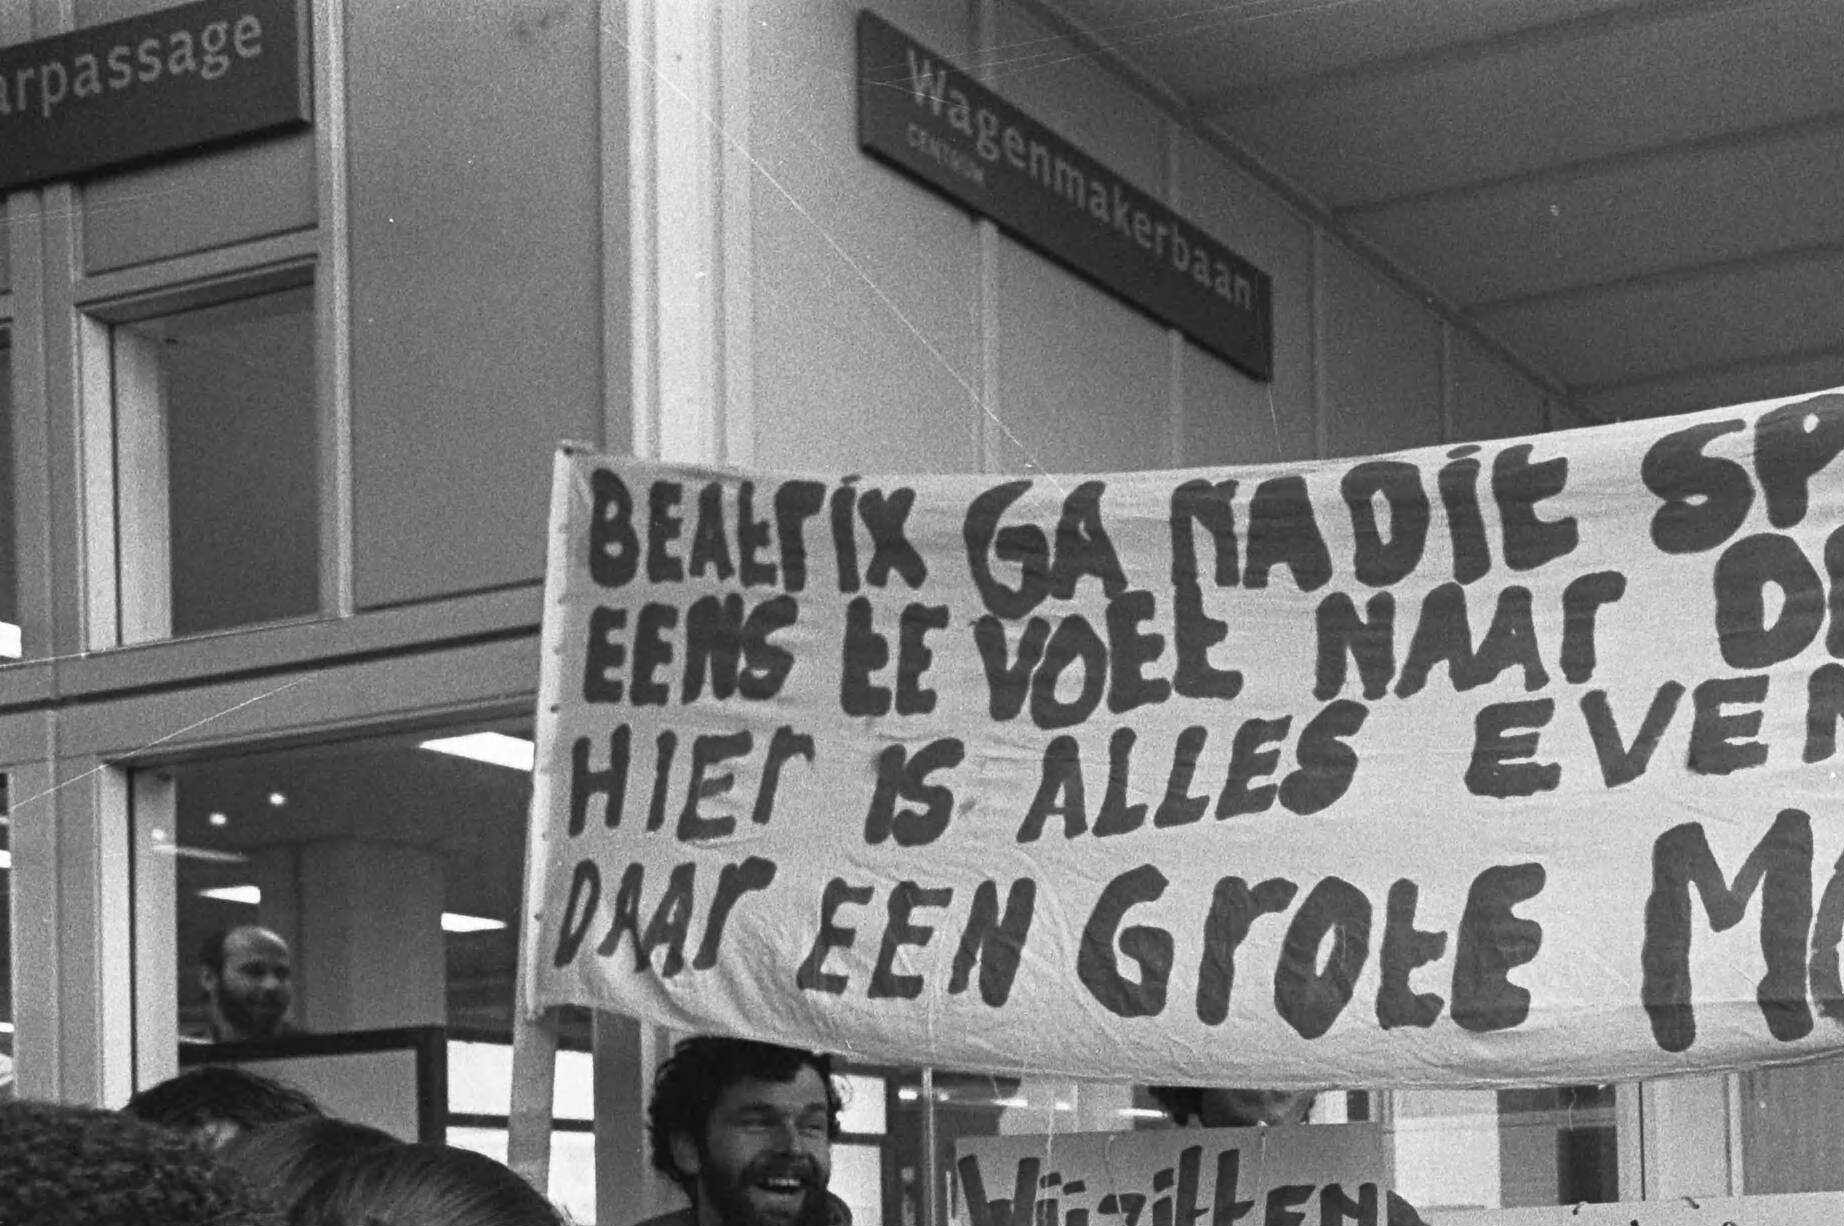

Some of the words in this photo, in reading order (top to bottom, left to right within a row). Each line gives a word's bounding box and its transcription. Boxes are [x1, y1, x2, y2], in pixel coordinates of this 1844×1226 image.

[908, 48, 1251, 310] Wagenmakerbaan
[963, 480, 1128, 619] GA
[583, 593, 798, 706] EENS
[1313, 570, 1627, 699] NAAr
[569, 723, 815, 841] HIEr
[865, 738, 964, 846] IS
[1016, 699, 1370, 843] ALLES
[553, 856, 777, 978] DAAr
[797, 877, 1036, 1008] EEN
